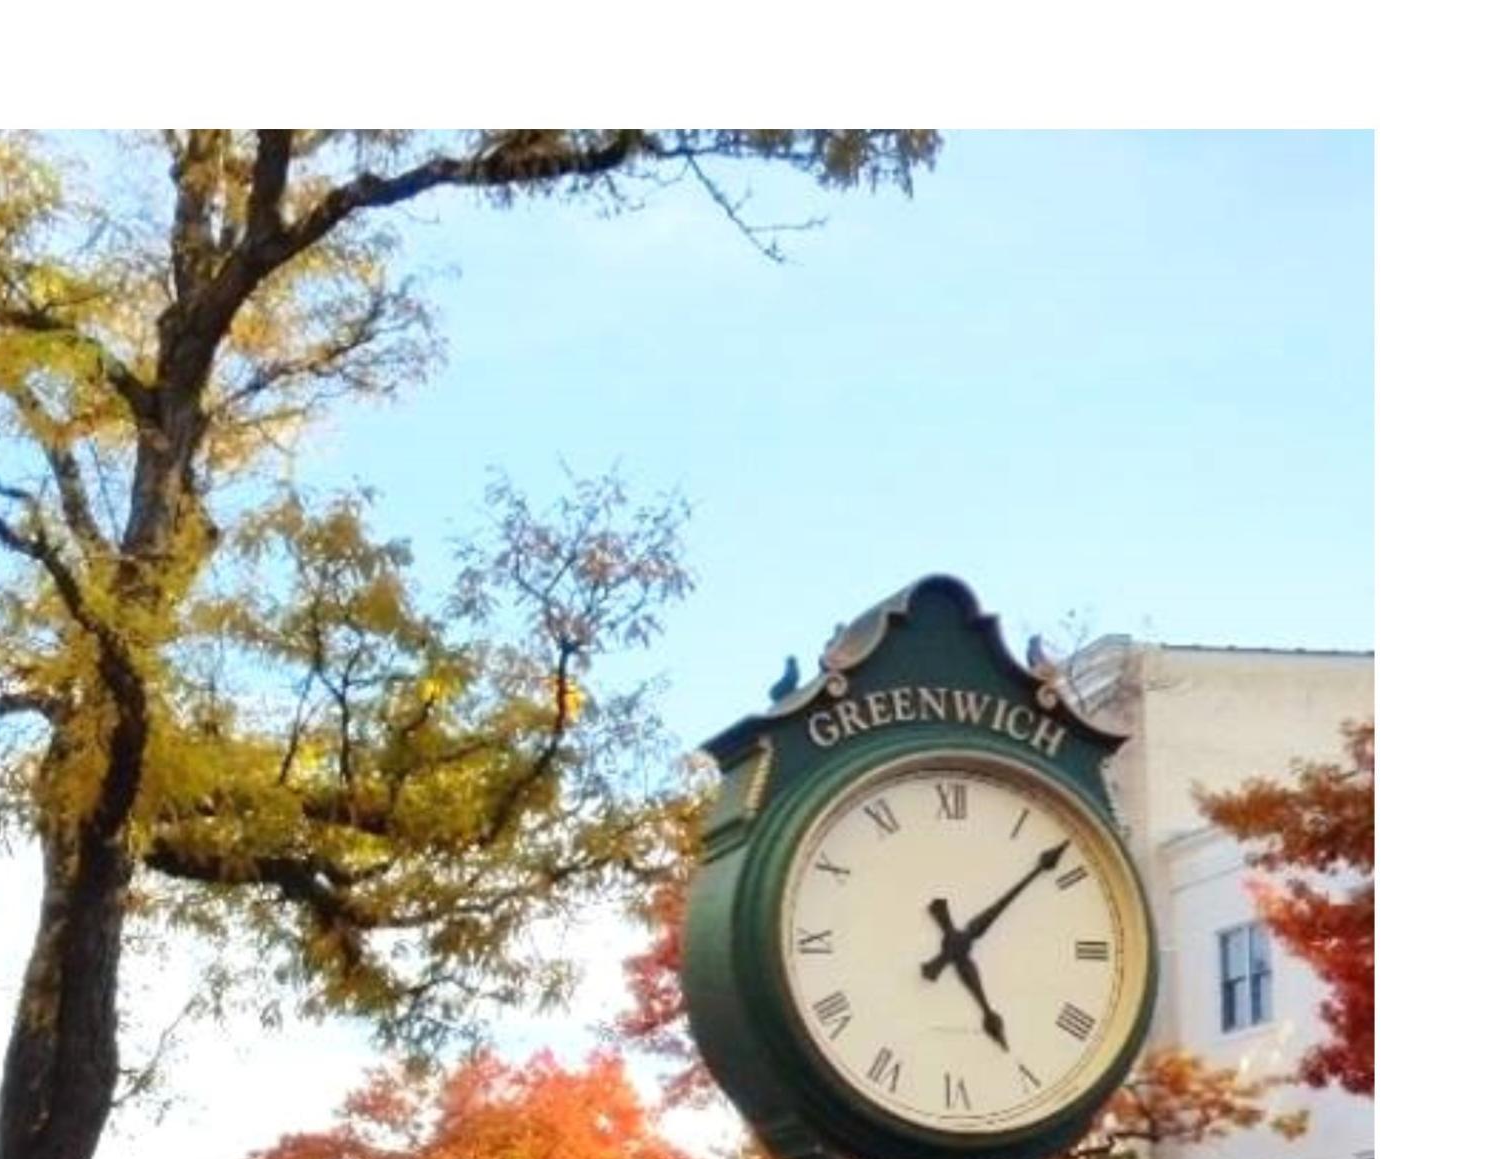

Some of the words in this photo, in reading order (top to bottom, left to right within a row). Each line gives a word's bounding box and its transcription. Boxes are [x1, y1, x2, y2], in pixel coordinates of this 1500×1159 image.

[808, 686, 1067, 756] GREENWICH
[863, 799, 900, 839] XI
[934, 783, 968, 820] XII
[1009, 807, 1031, 840] I
[814, 851, 851, 885] X
[1055, 865, 1089, 891] II
[796, 926, 834, 954] IX
[1075, 940, 1109, 961] III
[812, 990, 852, 1041] VIII
[866, 1046, 901, 1093] VII
[1017, 1063, 1042, 1094] V
[943, 1072, 971, 1111] VI
